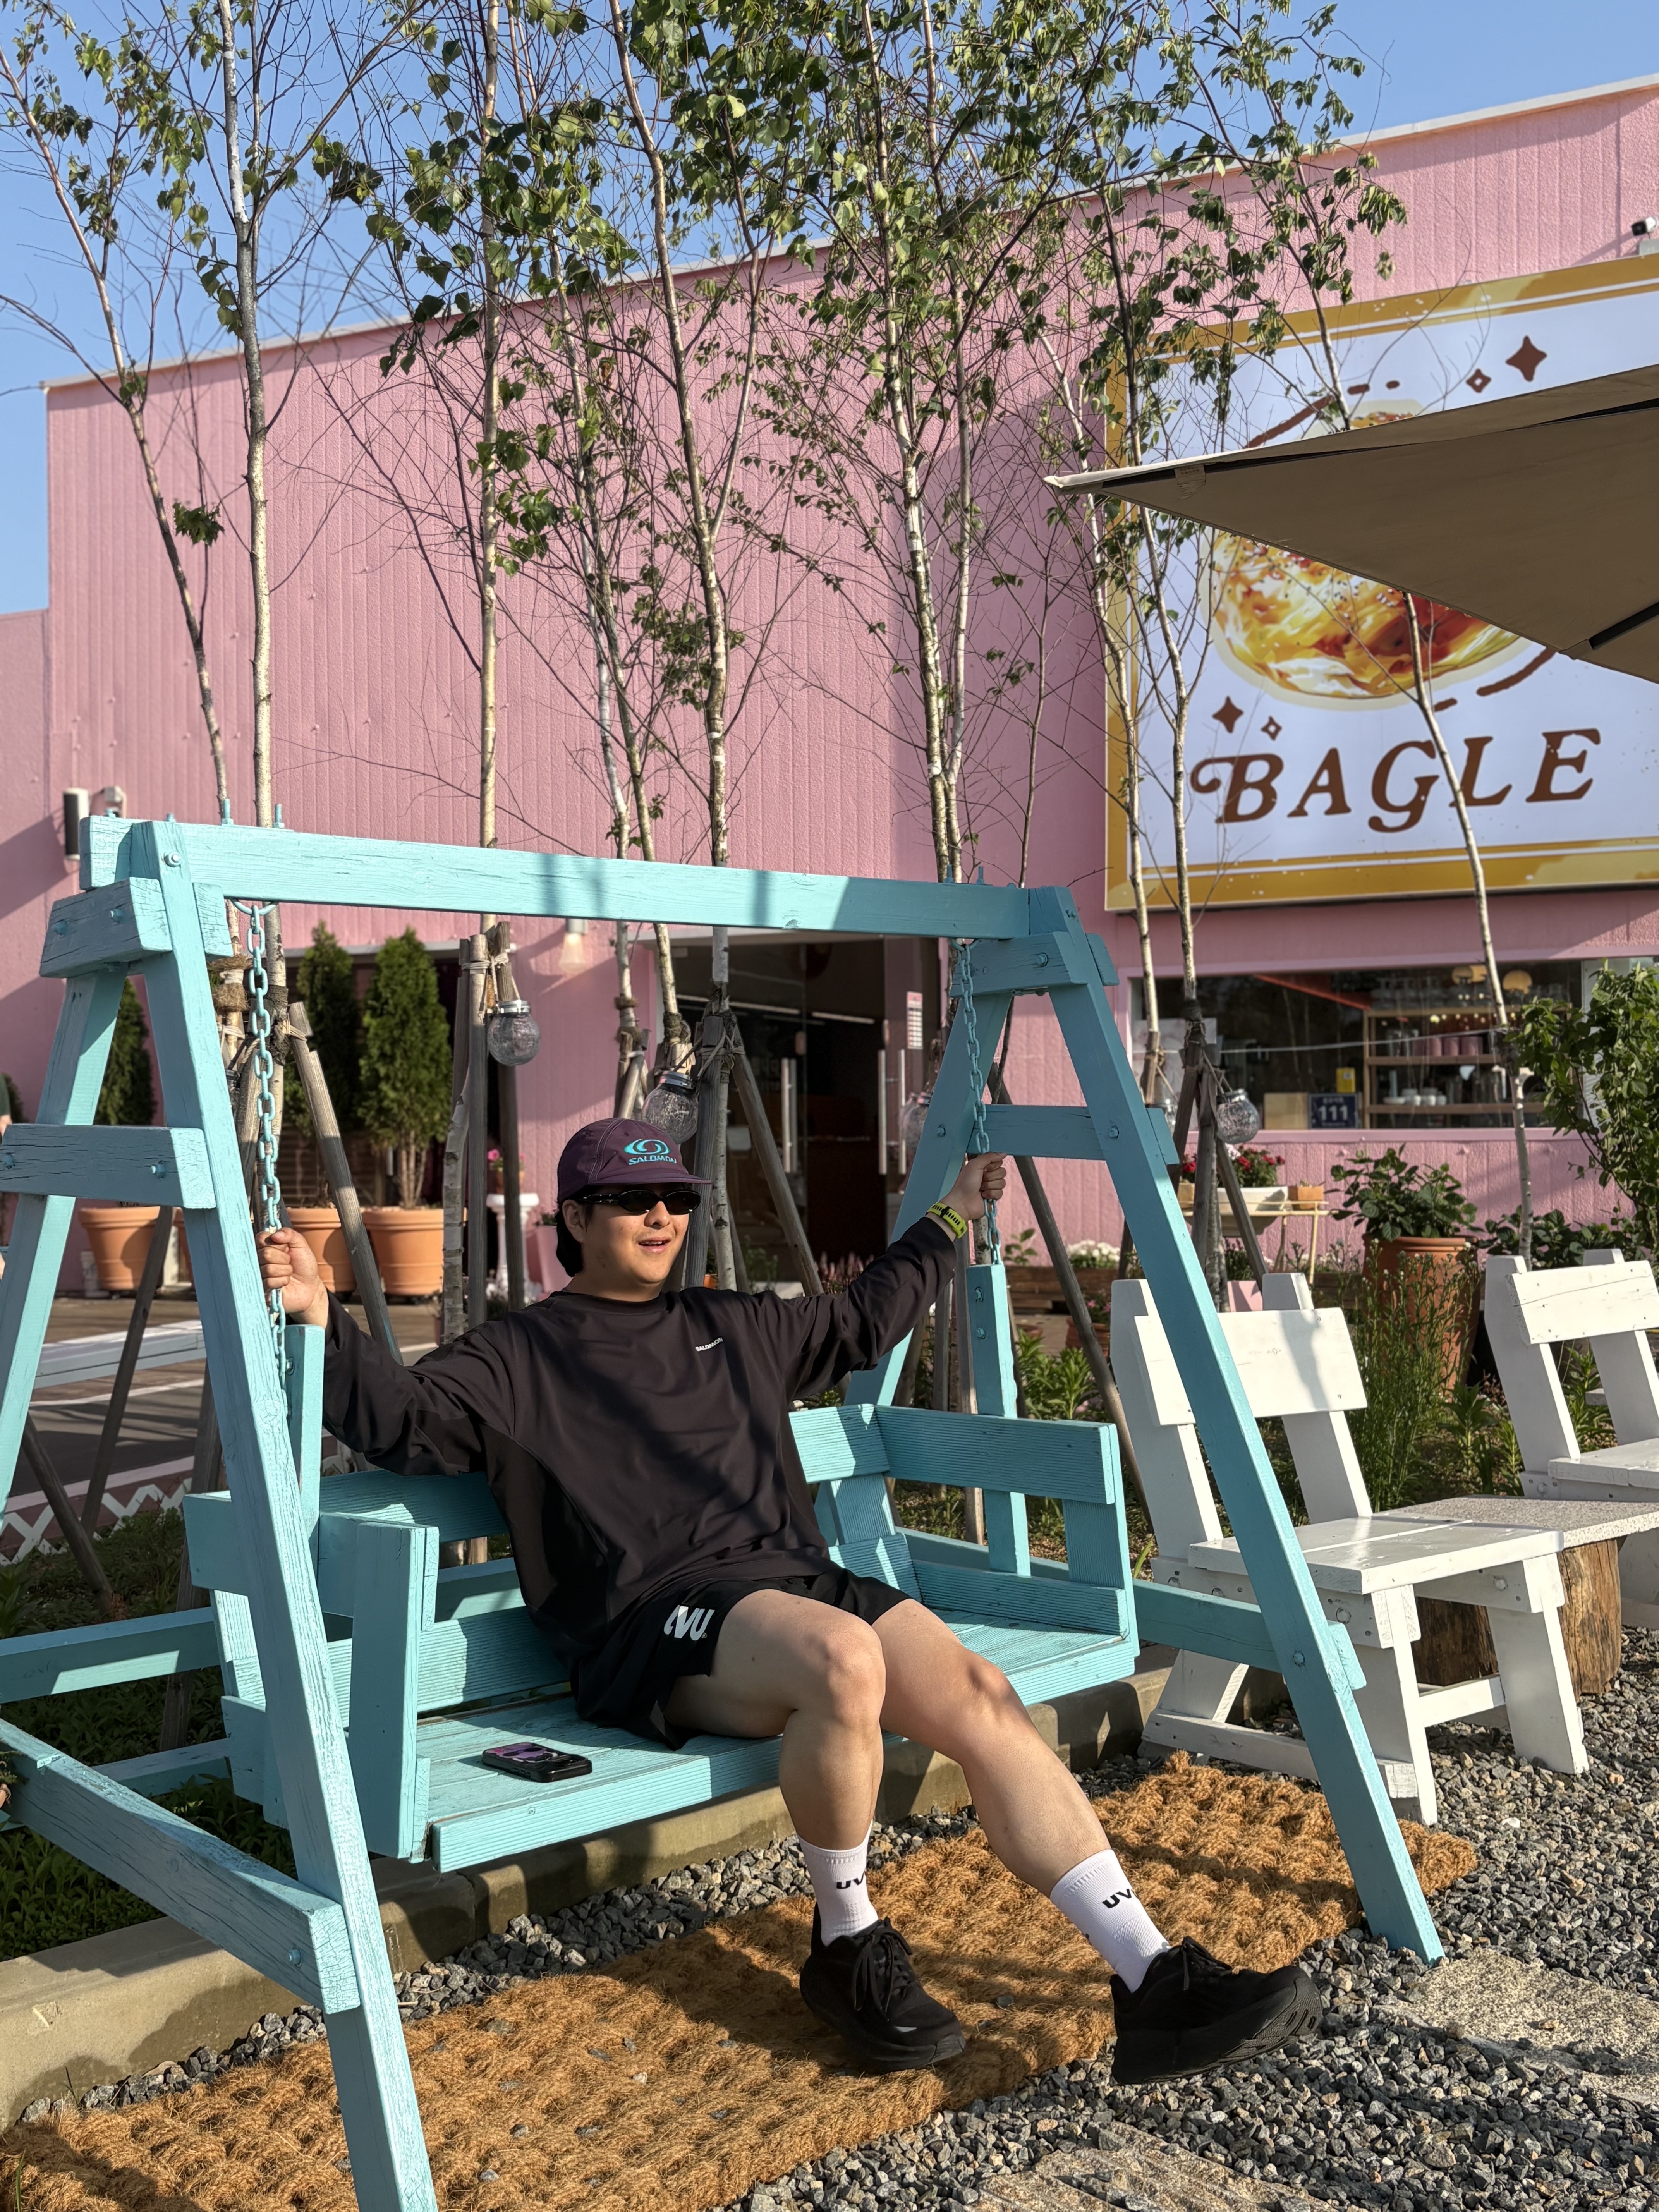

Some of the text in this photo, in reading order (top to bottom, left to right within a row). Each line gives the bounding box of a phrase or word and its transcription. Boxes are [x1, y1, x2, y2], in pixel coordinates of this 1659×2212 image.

[1190, 728, 1601, 833] BAGLE
[1319, 1105, 1348, 1121] 111
[629, 1155, 677, 1165] SALOMON
[695, 1337, 723, 1352] SALOMON
[1102, 1888, 1137, 1909] UV
